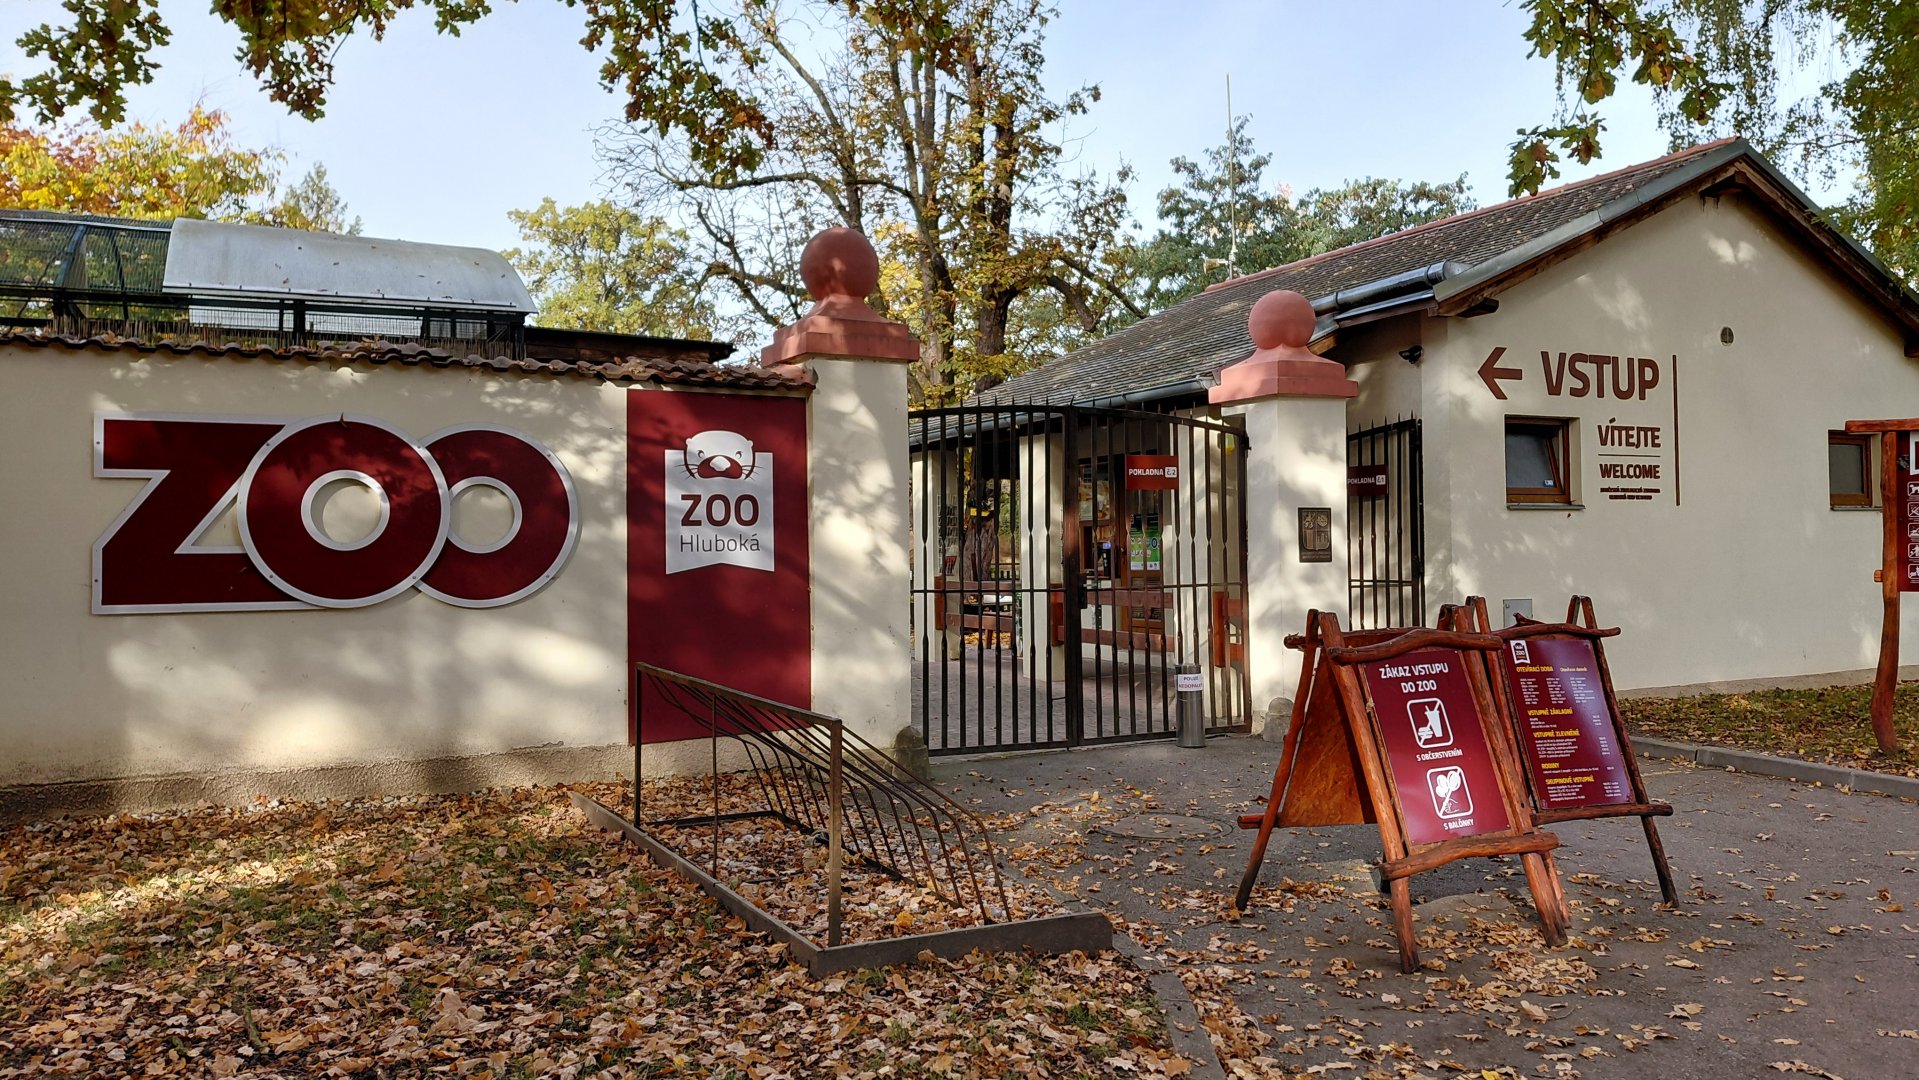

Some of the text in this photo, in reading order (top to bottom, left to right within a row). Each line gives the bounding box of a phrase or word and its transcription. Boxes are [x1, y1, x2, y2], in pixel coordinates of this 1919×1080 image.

[1541, 351, 1660, 401] VSTUP
[1597, 417, 1662, 449] VÍTEJTE
[1128, 468, 1164, 476] POKLADNA
[1599, 463, 1661, 480] WELCOME
[92, 411, 578, 614] ZOO
[680, 493, 760, 527] ZOO
[680, 533, 760, 552] Hluboká
[1379, 662, 1449, 679] ZÁKAZ VSTUPU
[1401, 679, 1437, 693] DO ZOO
[1416, 748, 1463, 762] S OBČERSTVENÍM
[1443, 822, 1449, 830] S
